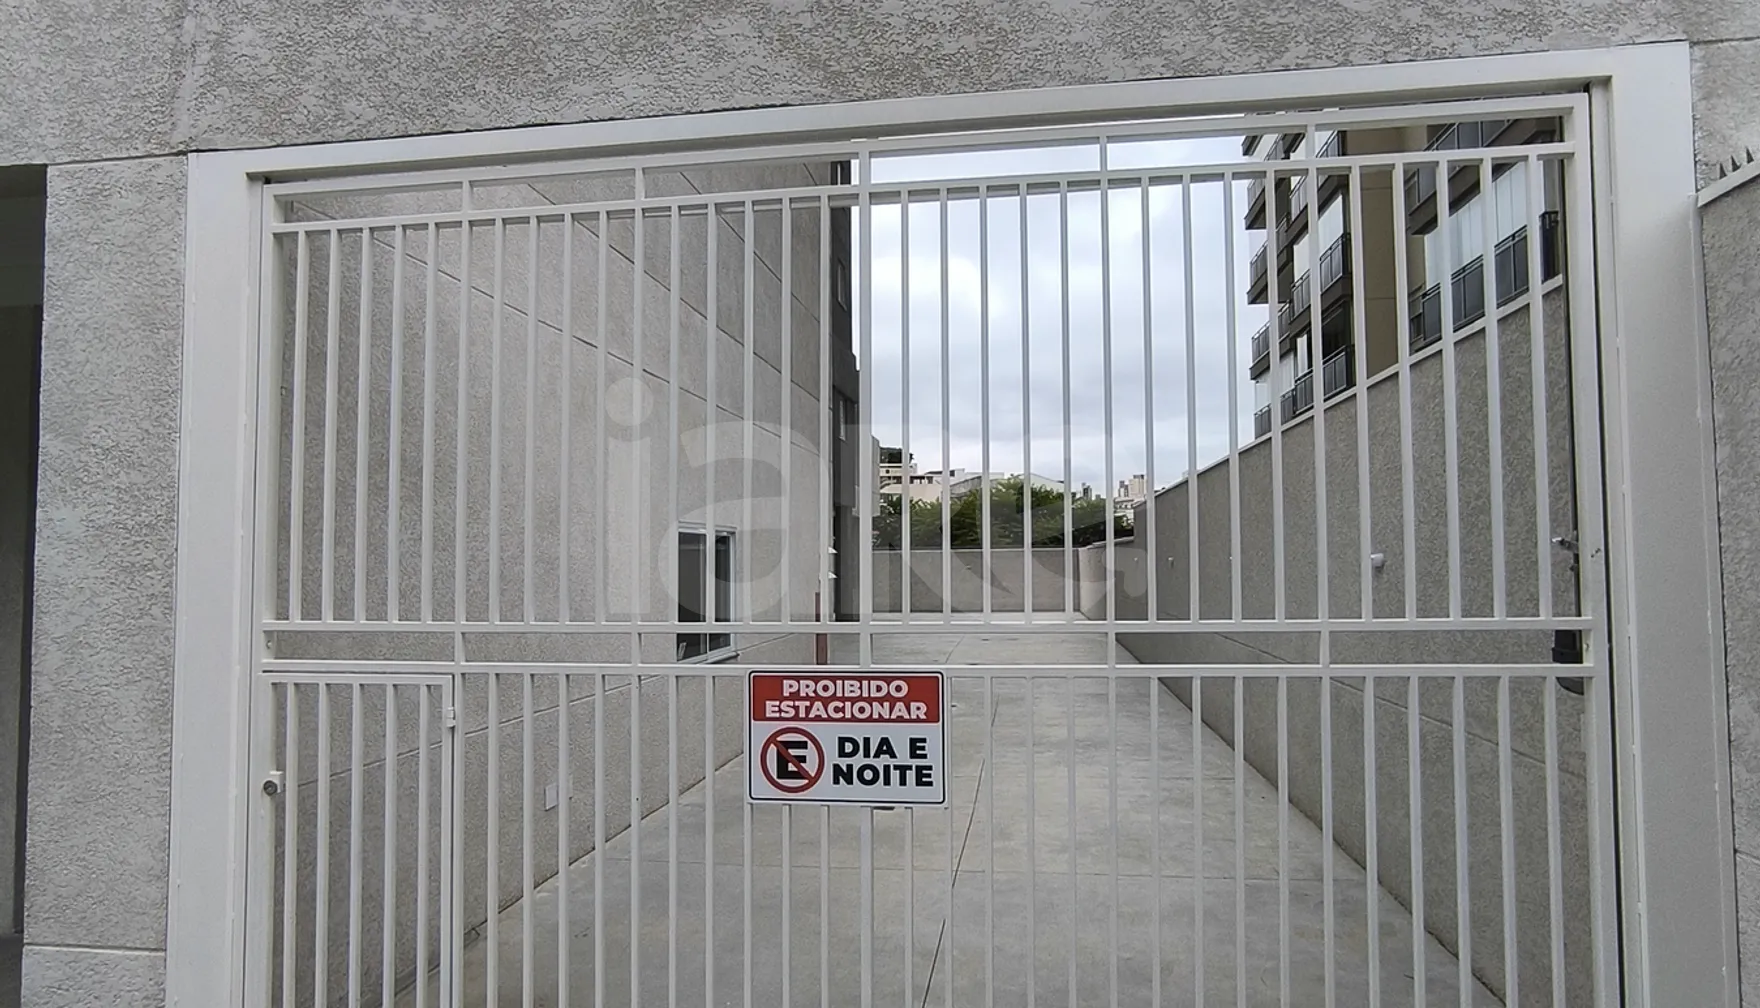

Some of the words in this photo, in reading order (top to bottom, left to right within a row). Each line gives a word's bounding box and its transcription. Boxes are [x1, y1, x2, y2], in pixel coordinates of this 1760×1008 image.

[783, 680, 908, 697] PROIBIDO
[765, 701, 927, 719] ESTACIONAR
[837, 737, 897, 759] DIA
[909, 737, 928, 759] E
[776, 741, 808, 780] E
[832, 763, 933, 786] NOITE
